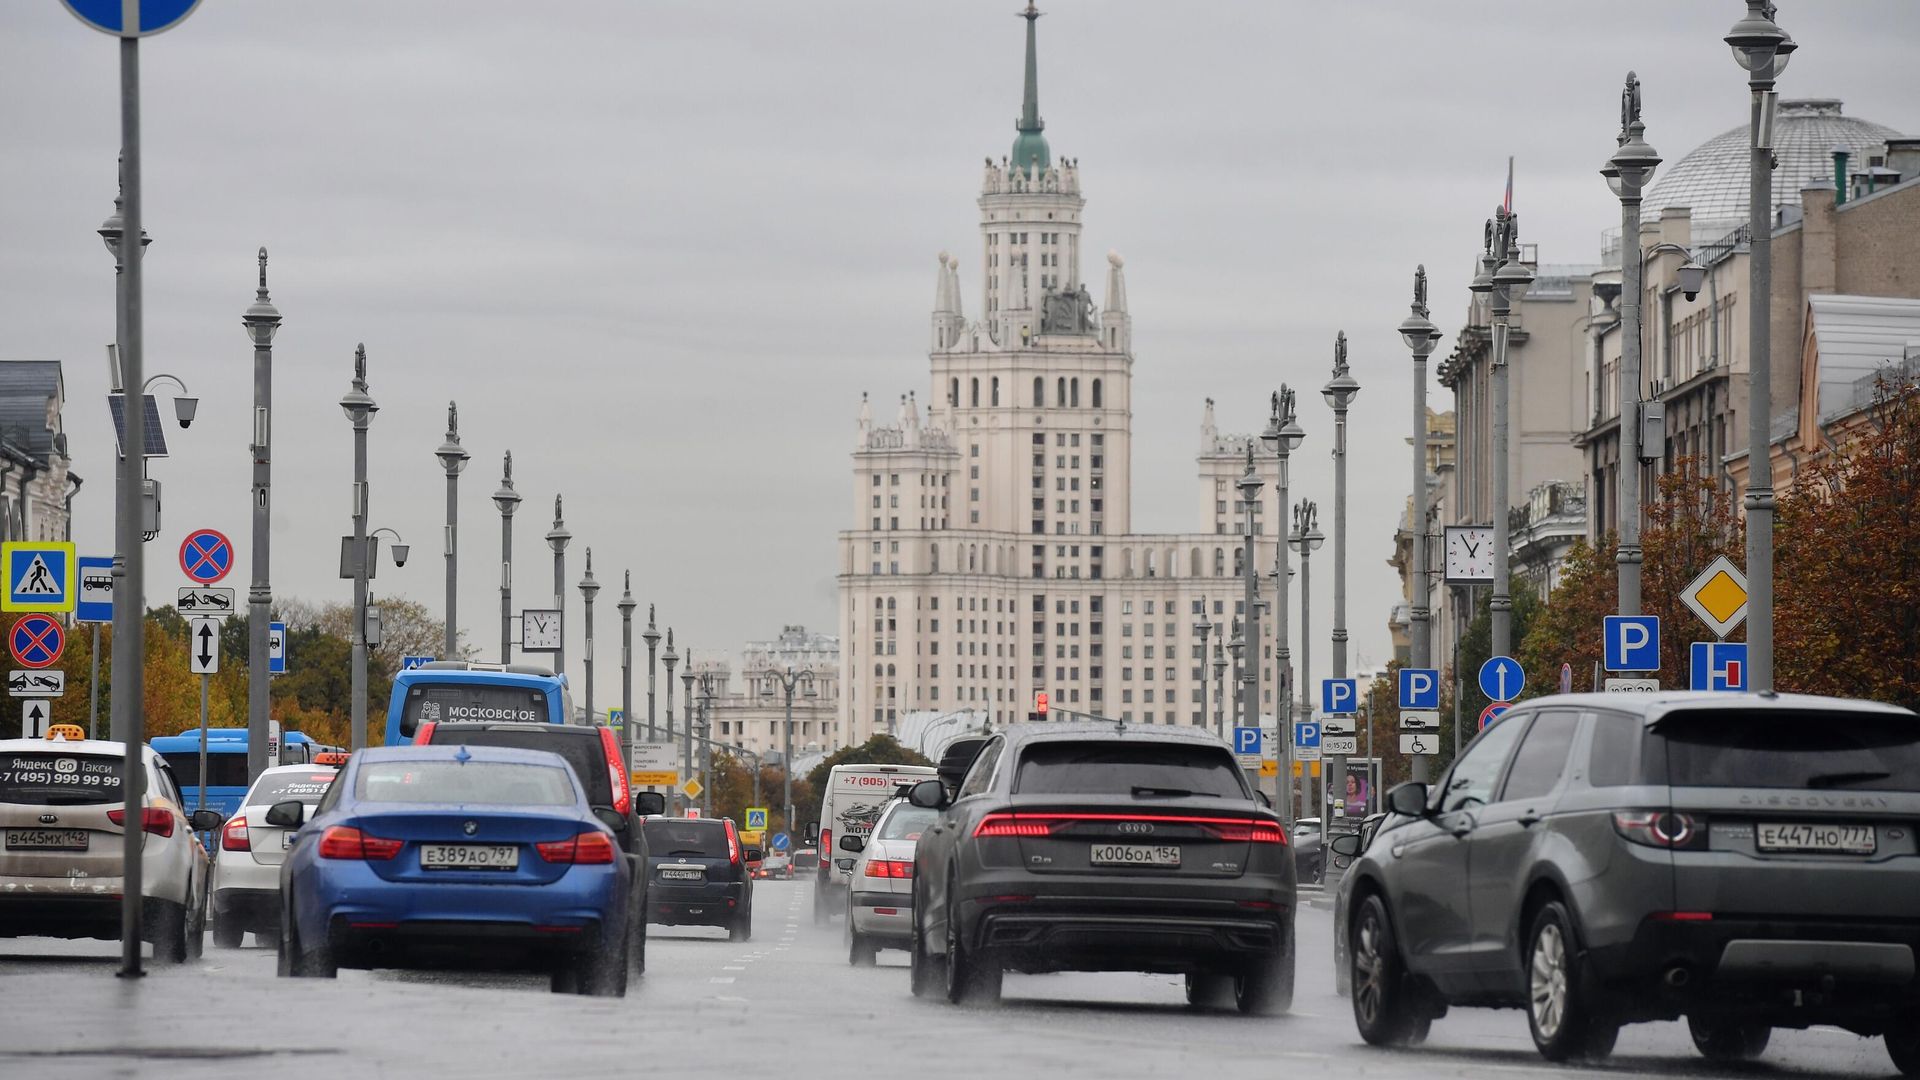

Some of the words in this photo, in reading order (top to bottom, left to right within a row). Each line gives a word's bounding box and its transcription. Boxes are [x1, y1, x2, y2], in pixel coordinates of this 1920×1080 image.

[1620, 622, 1649, 664] P
[1331, 682, 1351, 709] P
[1410, 673, 1432, 704] P
[449, 706, 535, 721] МОСКОВСКОЕ
[1241, 730, 1257, 752] P
[1302, 725, 1316, 745] P
[1342, 742, 1352, 750] 20
[12, 758, 53, 770] Яндекс
[81, 761, 112, 774] Такси
[15, 772, 51, 784] (495)
[54, 774, 79, 784] 999
[82, 776, 99, 785] 99
[103, 776, 120, 786] 99
[859, 777, 887, 787] (905)
[66, 832, 84, 841] 142
[1764, 826, 1839, 846] Е447НО
[1842, 826, 1869, 841] 777
[427, 848, 488, 863] Е389АО
[489, 848, 513, 860] 797
[1095, 846, 1153, 862] К006ОА
[1156, 847, 1177, 858] 154
